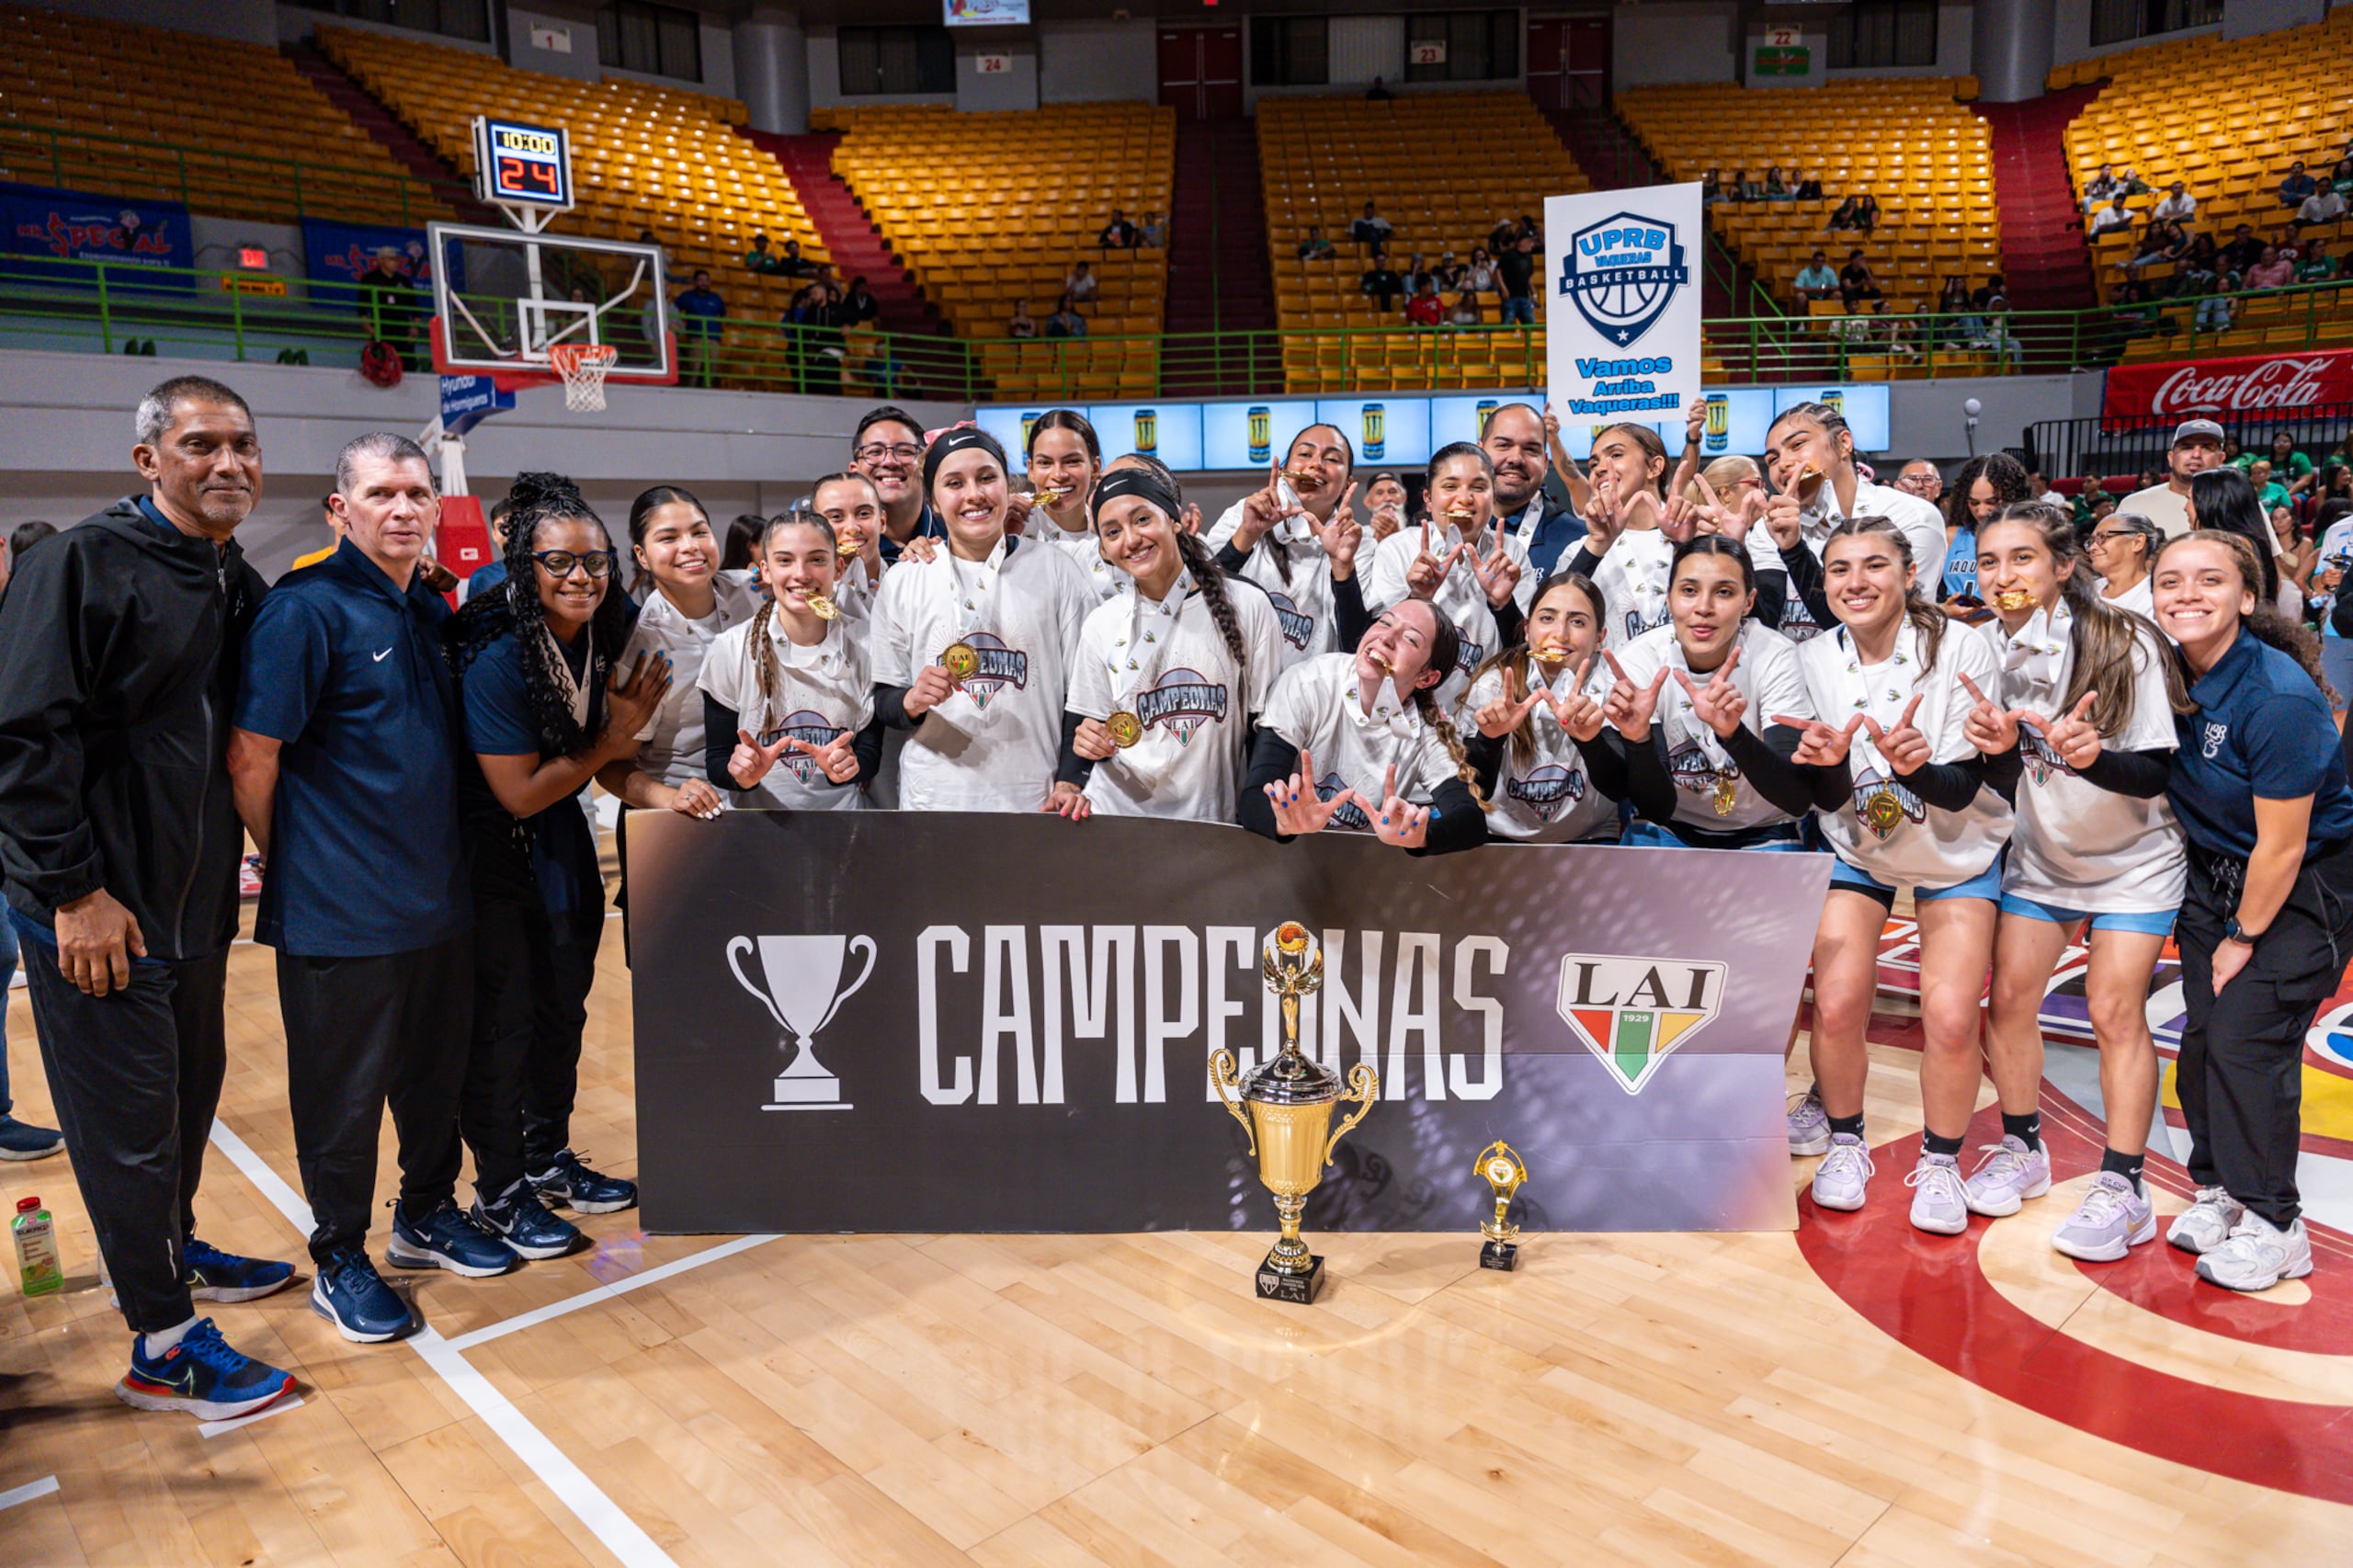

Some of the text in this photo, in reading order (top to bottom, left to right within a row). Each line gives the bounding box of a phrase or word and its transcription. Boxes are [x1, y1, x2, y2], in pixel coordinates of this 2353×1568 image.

[546, 35, 553, 49] 1
[1775, 31, 1791, 45] 22
[984, 58, 1001, 72] 24
[1420, 49, 1436, 62] 23
[502, 132, 555, 154] 10:00
[501, 157, 556, 193] 24
[1578, 228, 1666, 256] UPRB
[1594, 252, 1652, 267] VAQUERAS
[1565, 269, 1681, 289] BASKETBALL
[1575, 357, 1672, 379] Vamos
[442, 375, 476, 396] Hyundai
[1593, 379, 1655, 396] Arriba
[2152, 357, 2336, 415] Coca-Cola
[1568, 393, 1680, 416] Vaqueras!!!
[972, 684, 992, 694] LAI
[1138, 685, 1226, 728] CAMPEONAS
[1173, 720, 1194, 730] LAI
[794, 759, 814, 769] LAI
[1570, 962, 1715, 1010] LAI
[917, 924, 1509, 1106] CAMPEONAS
[1279, 1290, 1306, 1301] LAI
